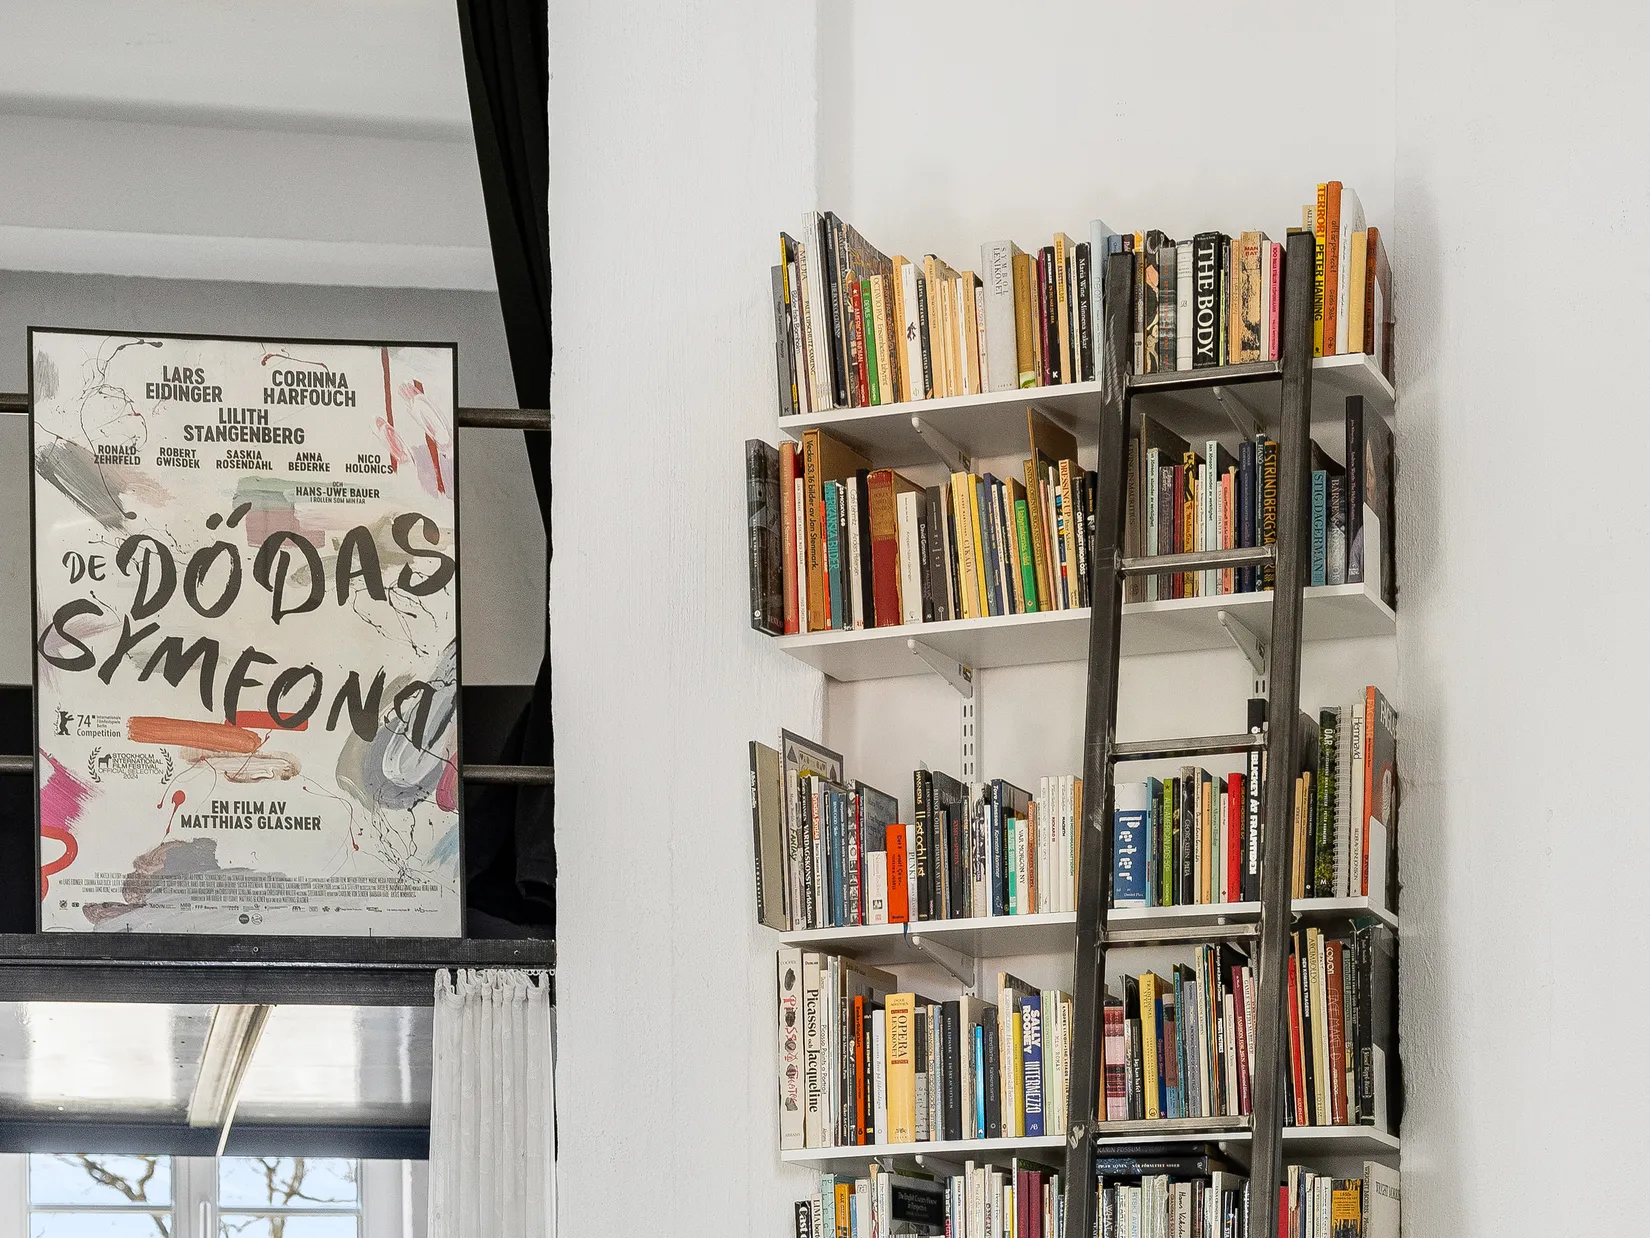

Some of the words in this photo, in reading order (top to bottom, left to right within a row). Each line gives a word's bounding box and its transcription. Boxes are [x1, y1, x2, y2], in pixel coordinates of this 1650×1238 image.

[1316, 186, 1326, 238] TERROR!
[993, 247, 1002, 296] LEXIKONET
[1197, 243, 1214, 292] THE
[1315, 244, 1325, 277] PETER
[873, 278, 883, 307] OCTAVIO
[1314, 280, 1324, 321] HAINING
[792, 309, 800, 323] från
[853, 308, 862, 339] AMERICAN
[875, 308, 884, 322] PAZ
[1080, 300, 1088, 330] Minnena
[1197, 294, 1214, 358] BODY
[877, 324, 886, 362] Ensamhetens
[162, 366, 205, 385] LARS
[272, 370, 348, 389] CORINNA
[146, 383, 223, 403] EIDINGER
[263, 388, 357, 407] HARFOUCH
[218, 407, 269, 425] LILITH
[184, 425, 305, 444] STANGENBERG
[94, 455, 141, 466] ZEHRFELD
[97, 444, 137, 455] RONALD
[159, 447, 197, 459] ROBERT
[226, 450, 263, 461] SASKIA
[296, 452, 322, 462] ANNA
[357, 454, 381, 463] NICO
[806, 440, 814, 462] Vecka
[156, 457, 201, 469] GWISDEK
[215, 460, 273, 471] ROSENDAHL
[288, 461, 331, 473] BEDERKE
[345, 463, 393, 475] HOLONICS
[295, 487, 347, 498] HANS-UWE
[350, 488, 380, 499] BAUER
[1060, 461, 1070, 504] DRESSING
[1313, 474, 1326, 501] STIG
[808, 484, 816, 506] bilder
[809, 508, 815, 517] av
[1062, 504, 1071, 517] UP
[810, 519, 818, 531] Jan
[1313, 504, 1326, 572] DAGERMAN
[811, 533, 819, 570] Stenmark.
[920, 539, 928, 565] Grossman
[964, 539, 972, 573] CIKADA
[62, 551, 106, 584] DE
[116, 501, 455, 625] DÖDAS
[77, 728, 121, 738] Competition
[1353, 716, 1362, 760] Hemmavid
[211, 800, 230, 814] EN
[233, 801, 262, 815] FILM
[266, 801, 287, 815] AV
[180, 814, 249, 829] MATTHIAS
[254, 815, 321, 831] GLASNER
[1118, 815, 1142, 882] Peter
[1019, 873, 1025, 884] NY
[1309, 938, 1318, 984] ARCIMBOLDO
[806, 989, 819, 1037] Picasso
[898, 1015, 907, 1058] OPERA
[1022, 1005, 1032, 1054] ROONEY
[1031, 1010, 1040, 1048] SALLY
[806, 1049, 820, 1113] Jacqueline
[1025, 1061, 1042, 1114] INTERMEZZO
[813, 1200, 821, 1222] LIMA
[1178, 1191, 1186, 1209] Hans
[799, 1206, 808, 1233] Cast
